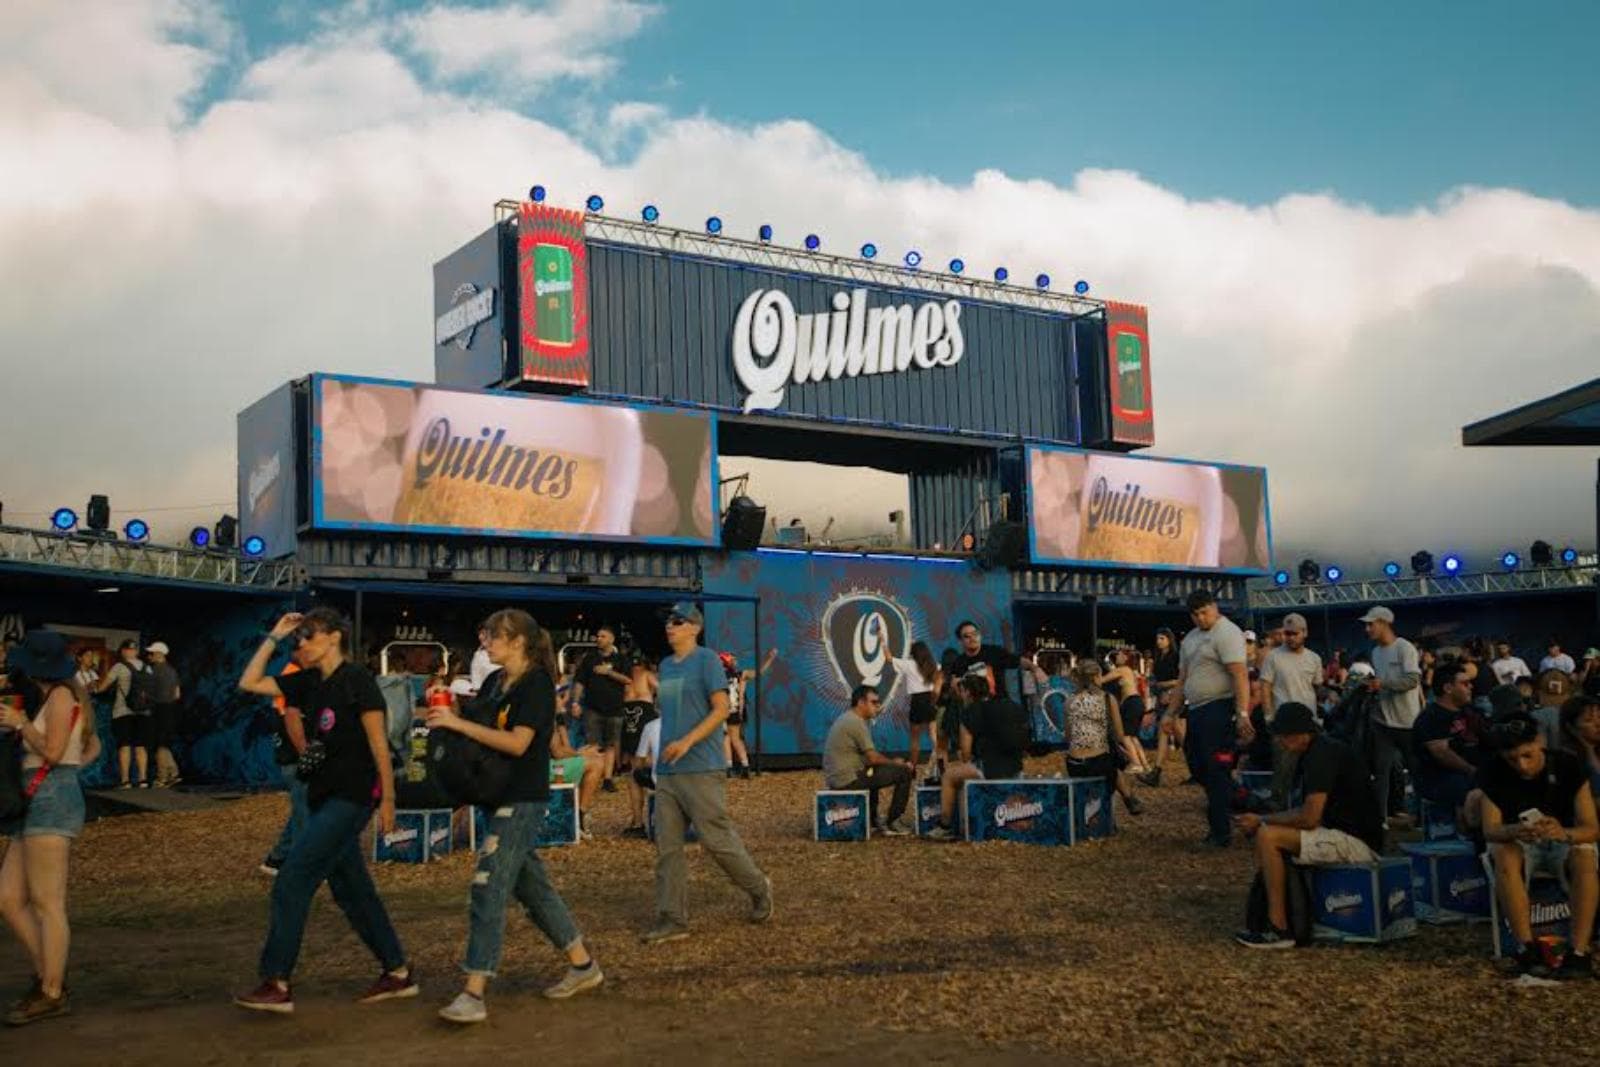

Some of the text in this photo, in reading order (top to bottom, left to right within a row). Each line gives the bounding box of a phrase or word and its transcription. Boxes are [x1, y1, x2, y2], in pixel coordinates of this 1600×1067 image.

[733, 288, 965, 414] Quilmes
[416, 416, 578, 499] Quilmes
[1088, 474, 1185, 539] Quilmes
[994, 801, 1044, 827] Quilmes
